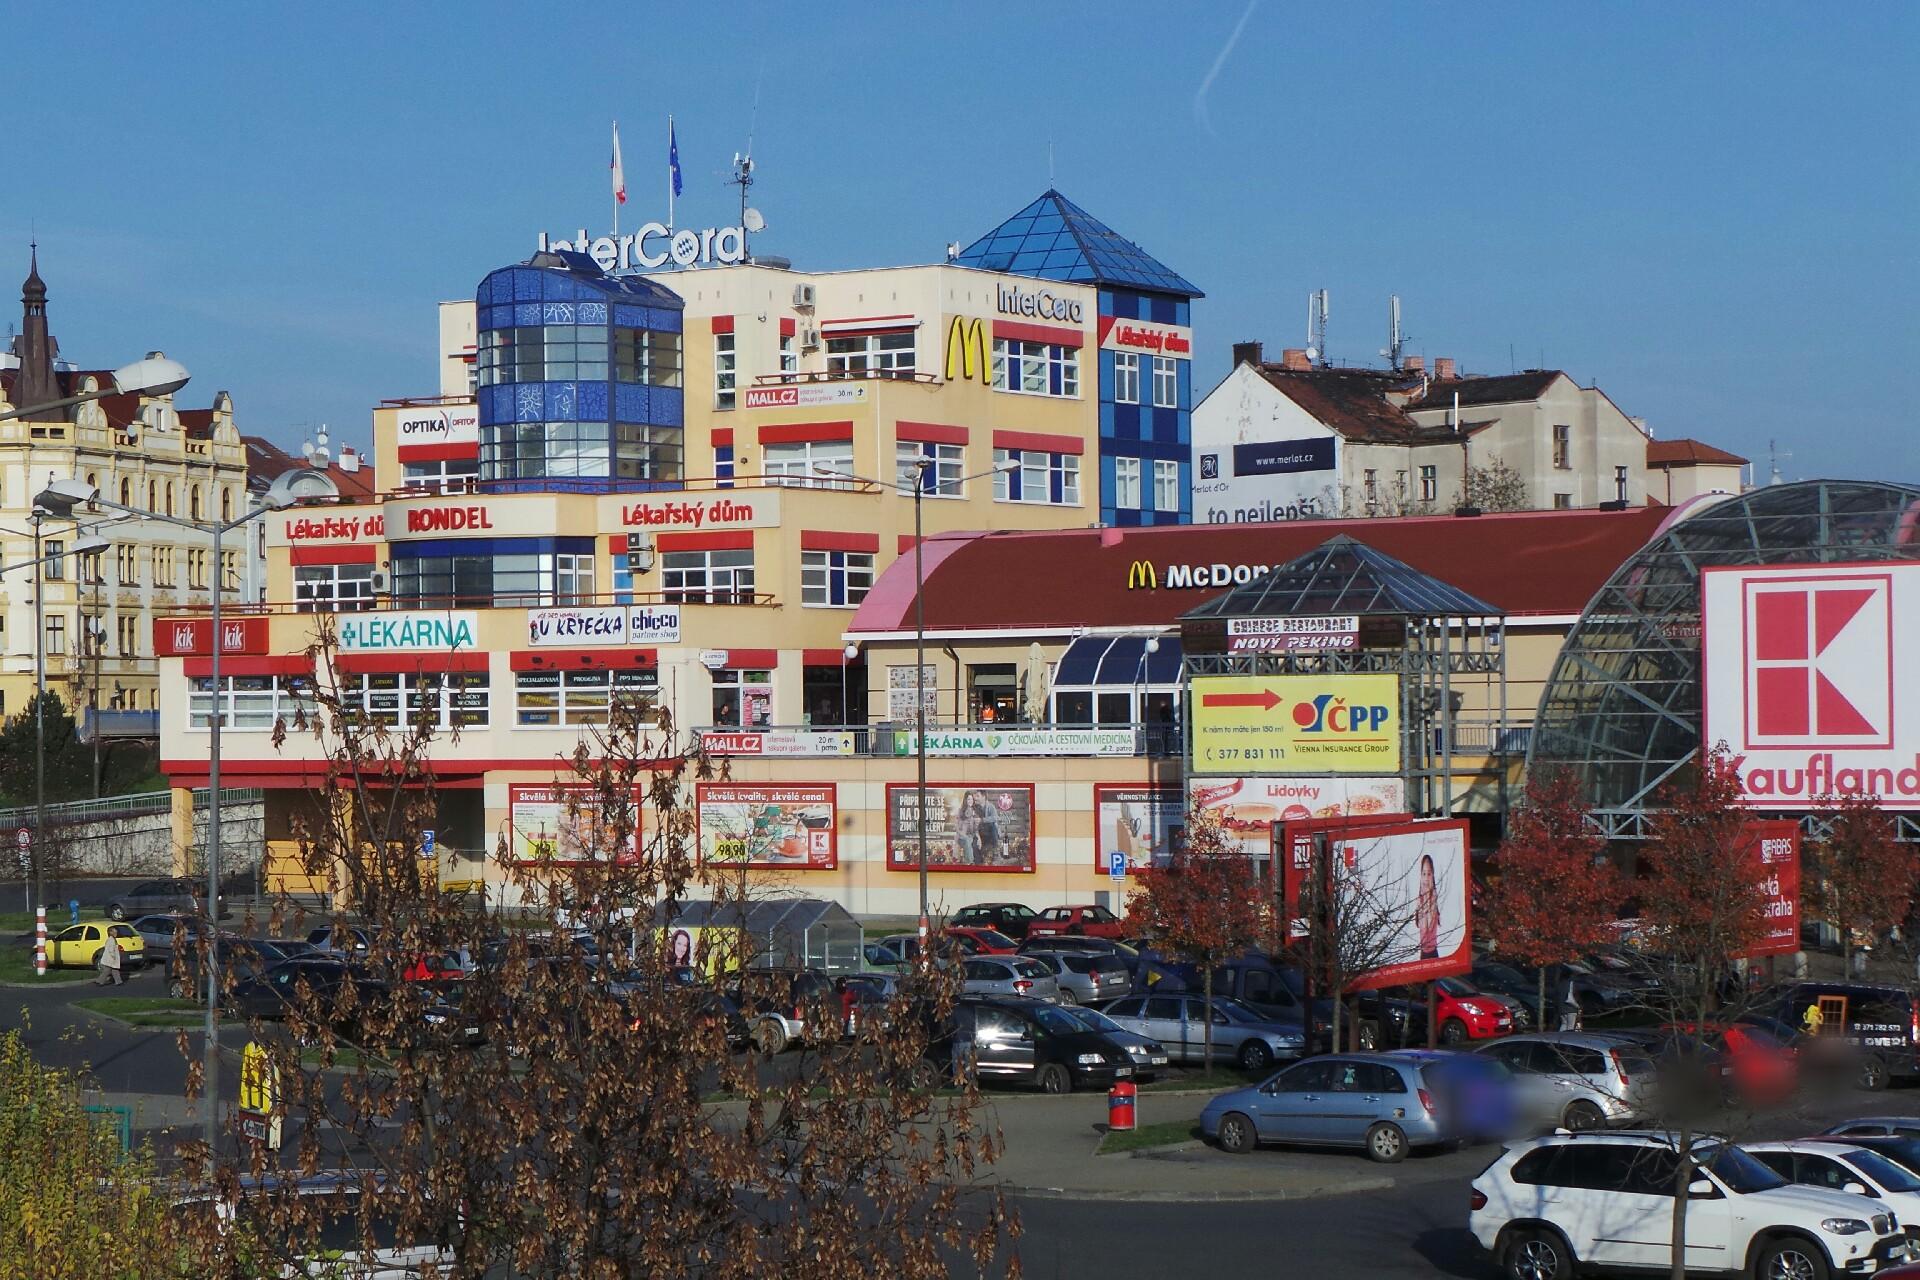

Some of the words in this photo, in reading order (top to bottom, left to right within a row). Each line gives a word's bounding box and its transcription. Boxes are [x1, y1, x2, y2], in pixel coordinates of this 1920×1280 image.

[996, 282, 1085, 323] InterCora
[748, 390, 796, 406] MALL.CZ
[403, 419, 446, 433] OPTIKA
[1256, 454, 1314, 465] www.merlot.cz
[408, 507, 493, 532] RONDEL
[622, 502, 704, 528] Lékařský
[710, 500, 753, 522] dům
[1208, 506, 1228, 523] to
[286, 516, 359, 542] Lékařský
[364, 514, 384, 536] dů
[540, 620, 550, 635] U
[557, 611, 622, 636] KRTEČKA
[632, 608, 677, 631] chicco
[175, 623, 194, 647] kik
[224, 623, 243, 647] kik
[359, 615, 473, 648] LÉKÁRNA
[632, 631, 658, 640] partner
[660, 630, 678, 640] shop
[1234, 635, 1281, 649] NOVÝ
[1287, 635, 1354, 648] PEKING
[1328, 697, 1389, 732] ČPP
[705, 736, 760, 751] MALL.CZ
[914, 735, 984, 749] LÉKÁRNA
[1008, 733, 1047, 745] OČKOVÁNÍ
[1055, 733, 1092, 744] CESTOVNÍ
[1094, 732, 1132, 744] MEDICÍNA
[1219, 748, 1239, 759] 377
[1244, 748, 1264, 759] 831
[1270, 748, 1285, 759] 111
[520, 791, 546, 801] Skvělá
[707, 791, 735, 801] Skvělá
[771, 791, 799, 801] skvělá
[900, 794, 935, 806] PŘIPRTE
[1267, 784, 1320, 800] Lidovky
[900, 807, 912, 820] NA
[914, 805, 945, 821] DOUHÉ
[925, 820, 946, 832] EČERY
[1772, 838, 1792, 855] ABAS
[1112, 854, 1123, 869] P
